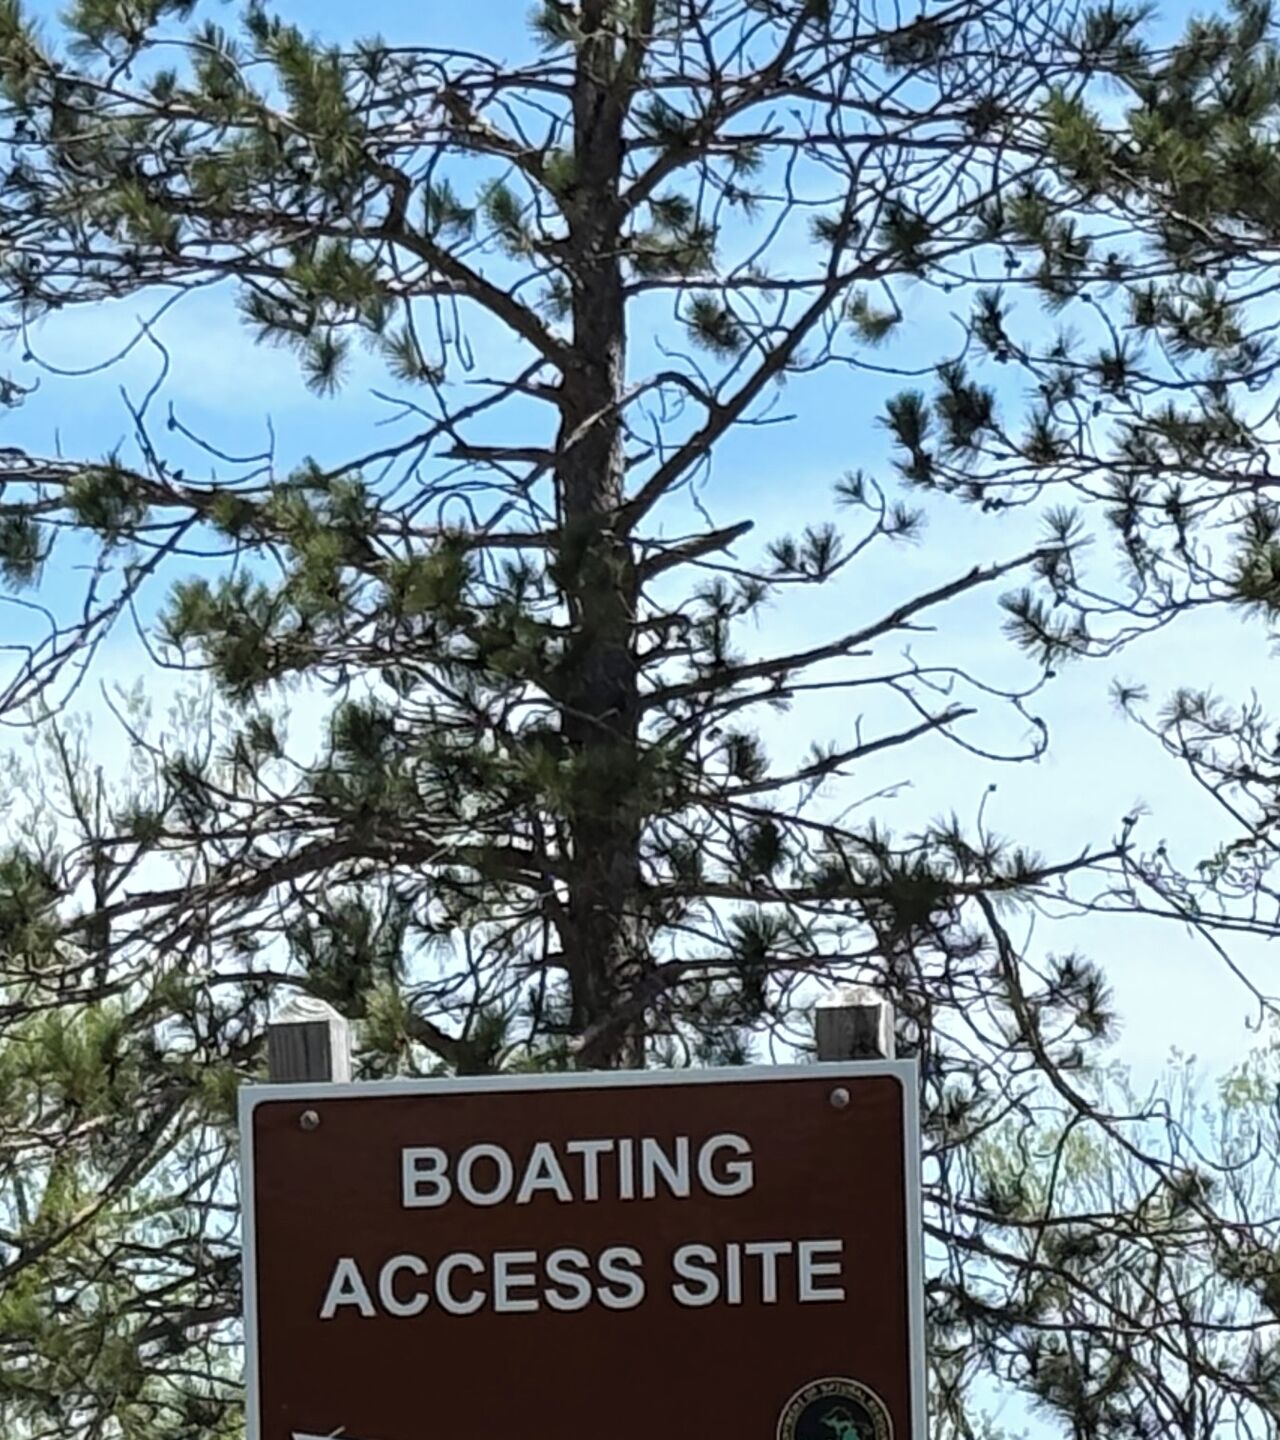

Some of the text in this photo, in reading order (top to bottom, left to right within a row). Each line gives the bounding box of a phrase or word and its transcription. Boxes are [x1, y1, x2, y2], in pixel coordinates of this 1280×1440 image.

[403, 1134, 753, 1207] BOATING
[320, 1240, 844, 1318] ACCESS SITE
